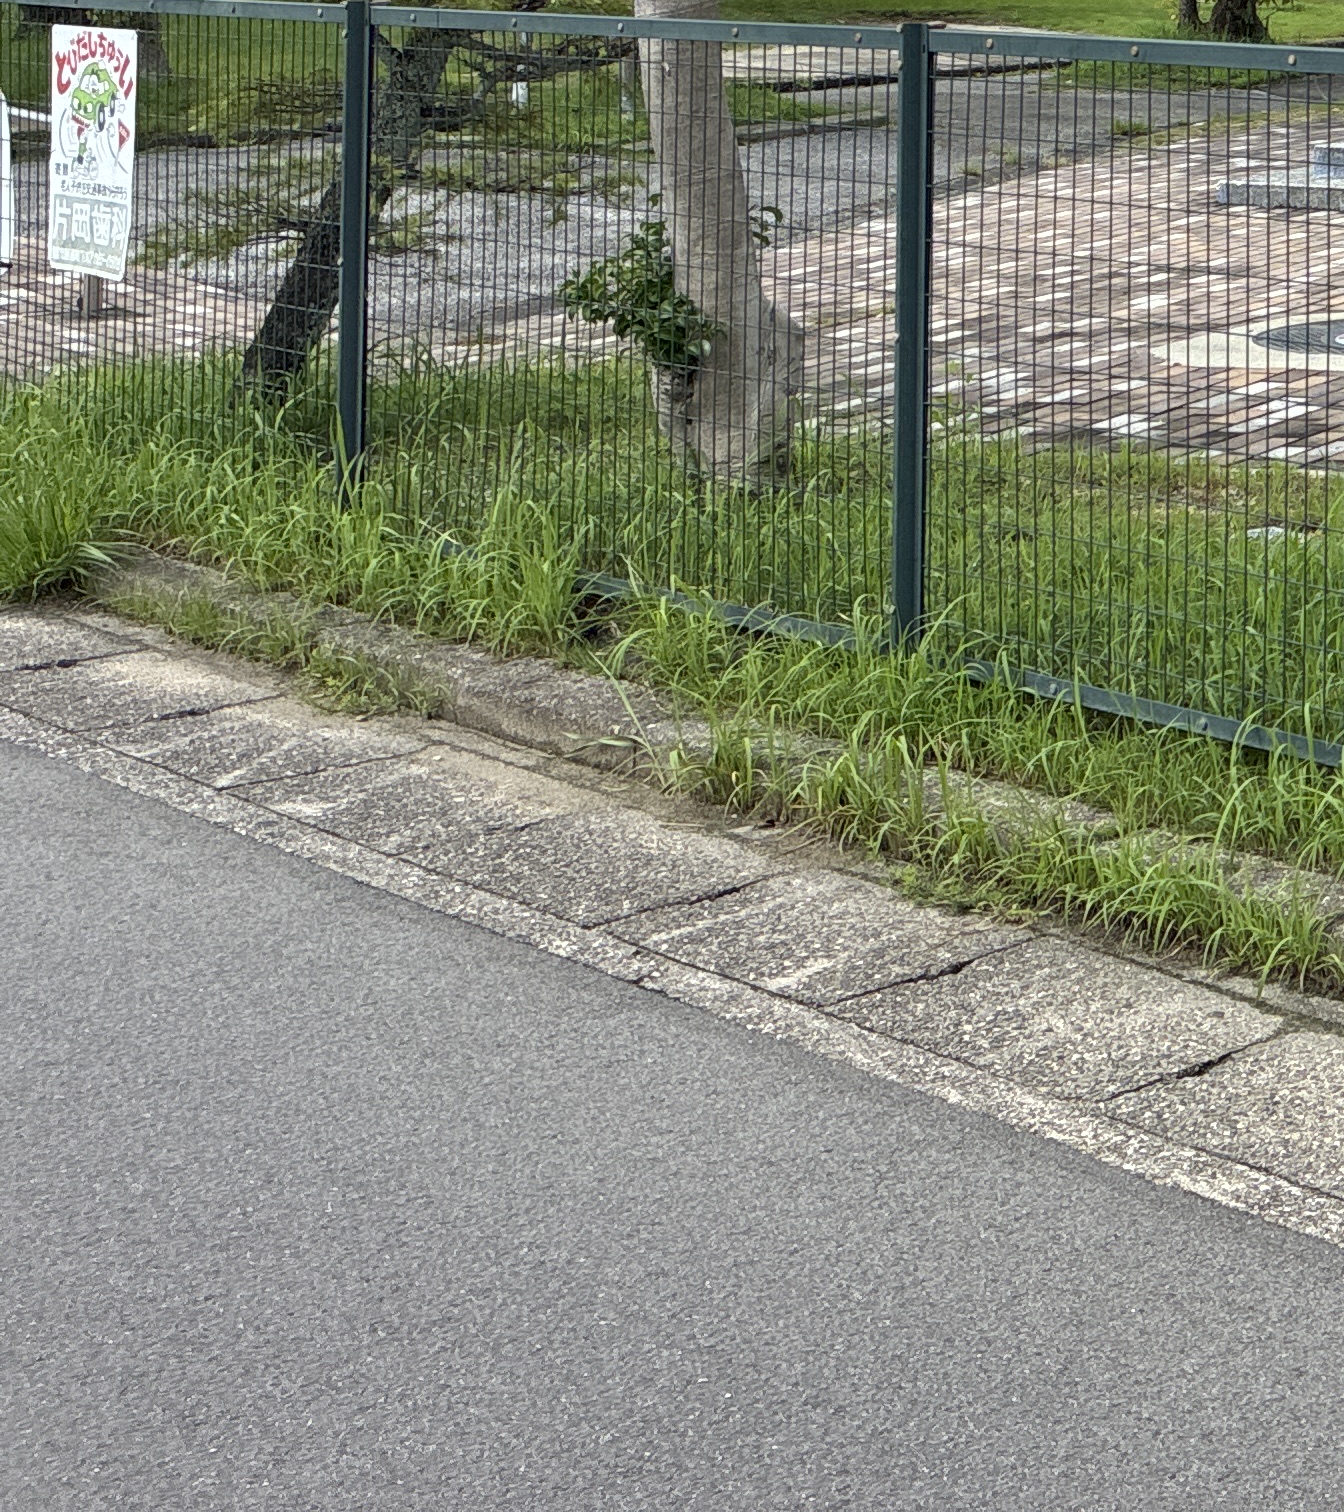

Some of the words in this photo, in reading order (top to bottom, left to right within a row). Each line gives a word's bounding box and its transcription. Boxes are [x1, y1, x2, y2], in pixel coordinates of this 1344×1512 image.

[55, 30, 134, 100] とびだしちゅうい
